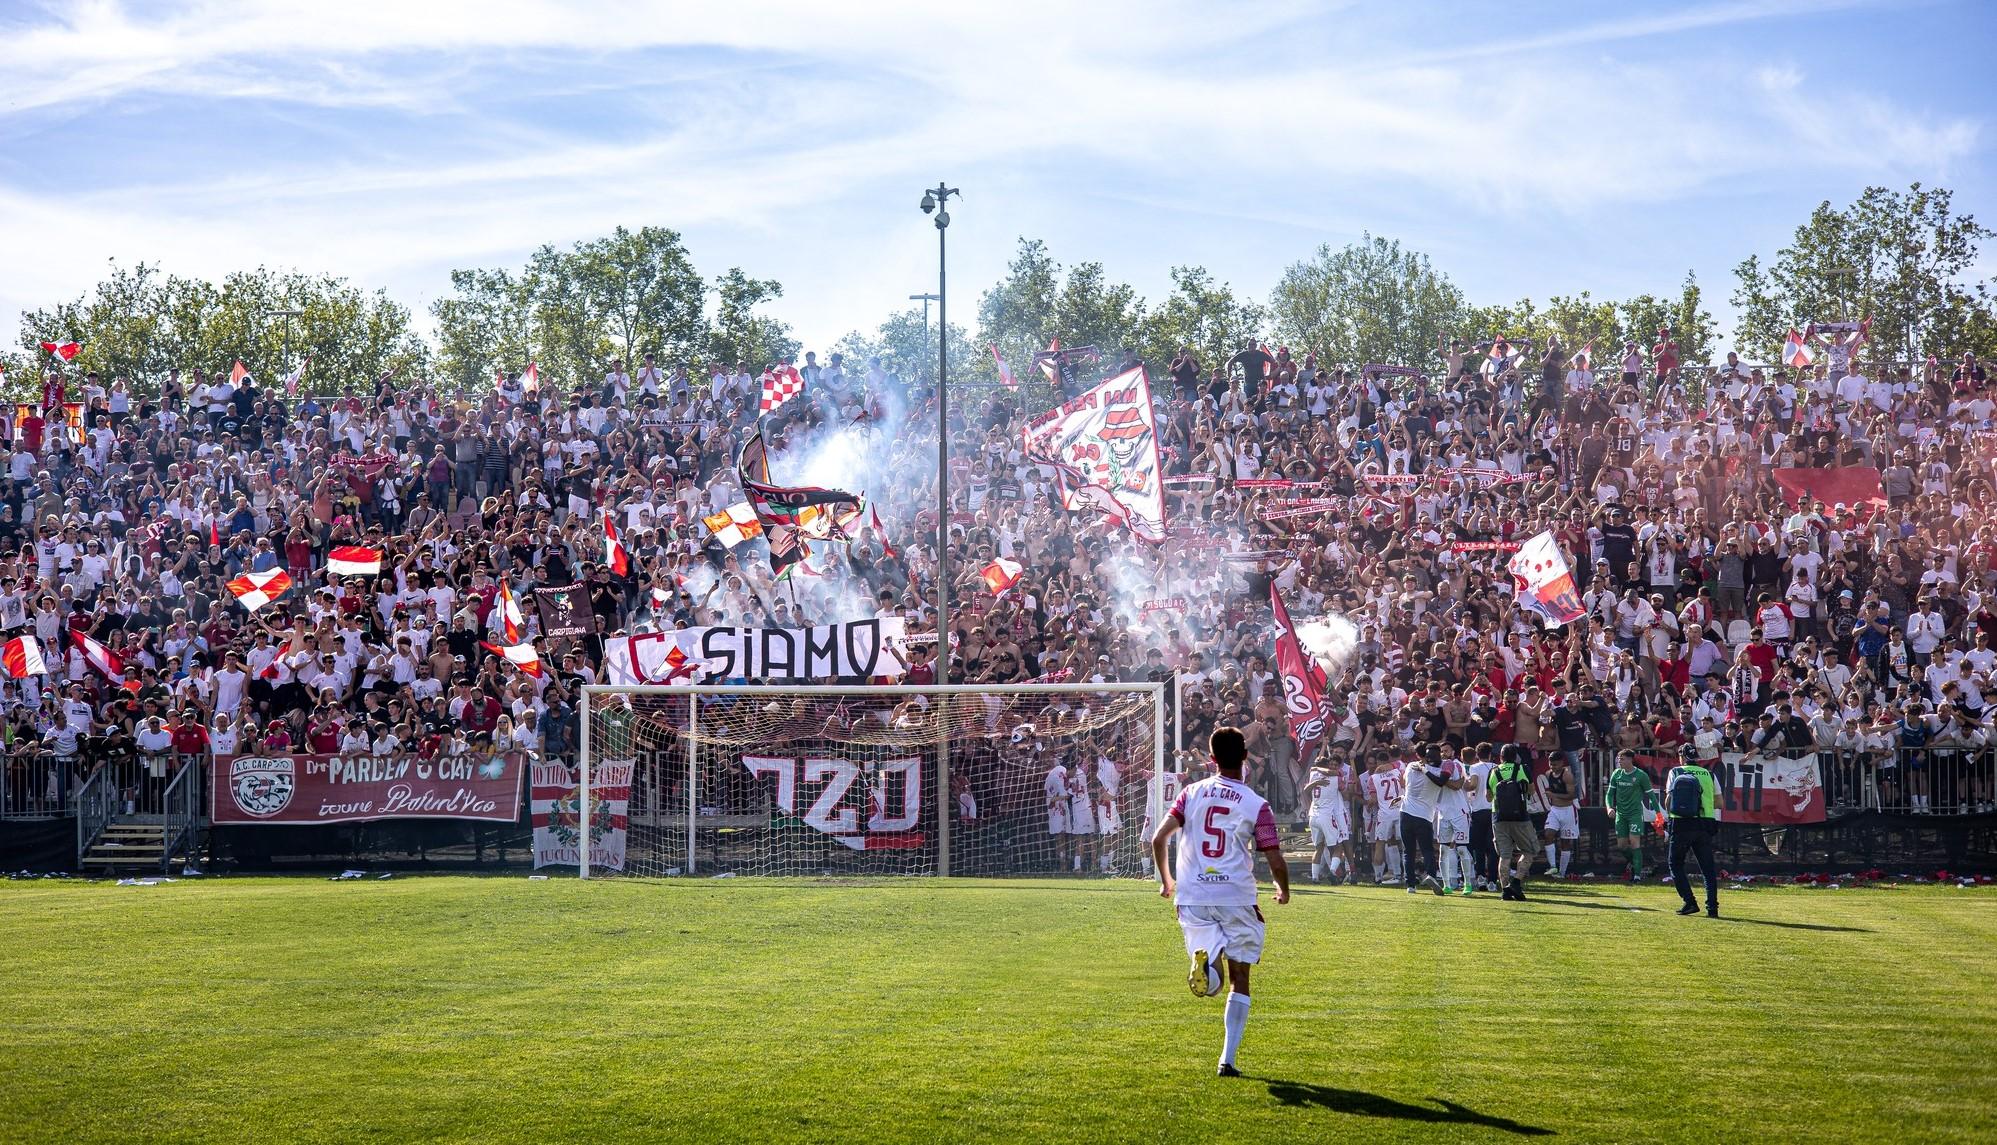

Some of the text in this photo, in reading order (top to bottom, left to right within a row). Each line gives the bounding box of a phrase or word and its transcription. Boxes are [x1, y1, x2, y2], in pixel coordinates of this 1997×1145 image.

[1617, 438, 1631, 452] 18
[1927, 463, 1944, 483] LA
[1220, 787, 1243, 804] CARPI
[1380, 777, 1400, 801] 21
[1202, 805, 1231, 858] 5
[540, 848, 620, 867] JUCUNITAS
